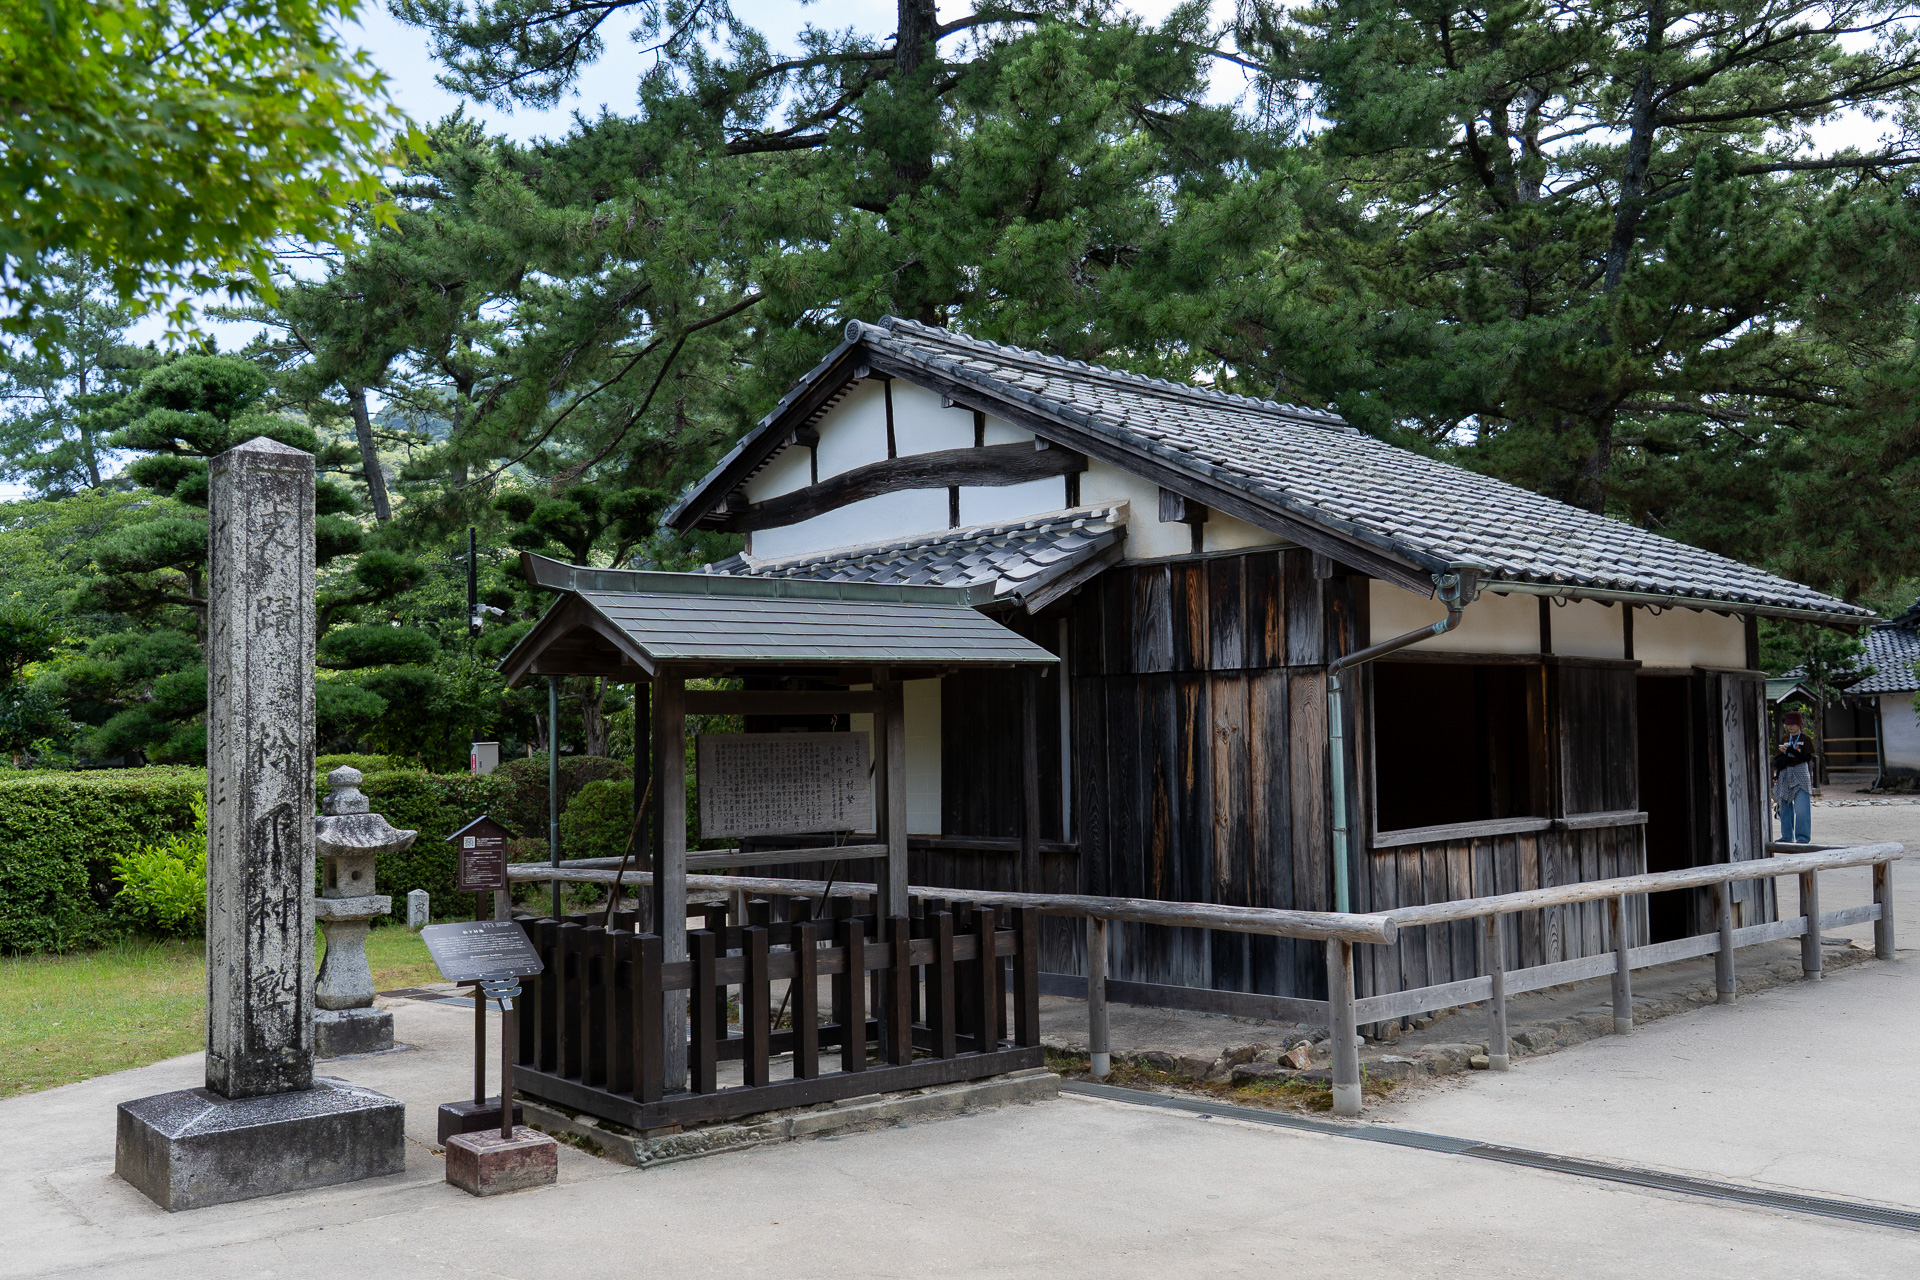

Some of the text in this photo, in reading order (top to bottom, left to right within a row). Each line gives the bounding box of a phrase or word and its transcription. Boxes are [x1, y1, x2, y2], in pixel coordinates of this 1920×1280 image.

[844, 755, 855, 804] 松下村塾
[249, 721, 296, 1012] 松下村塾
